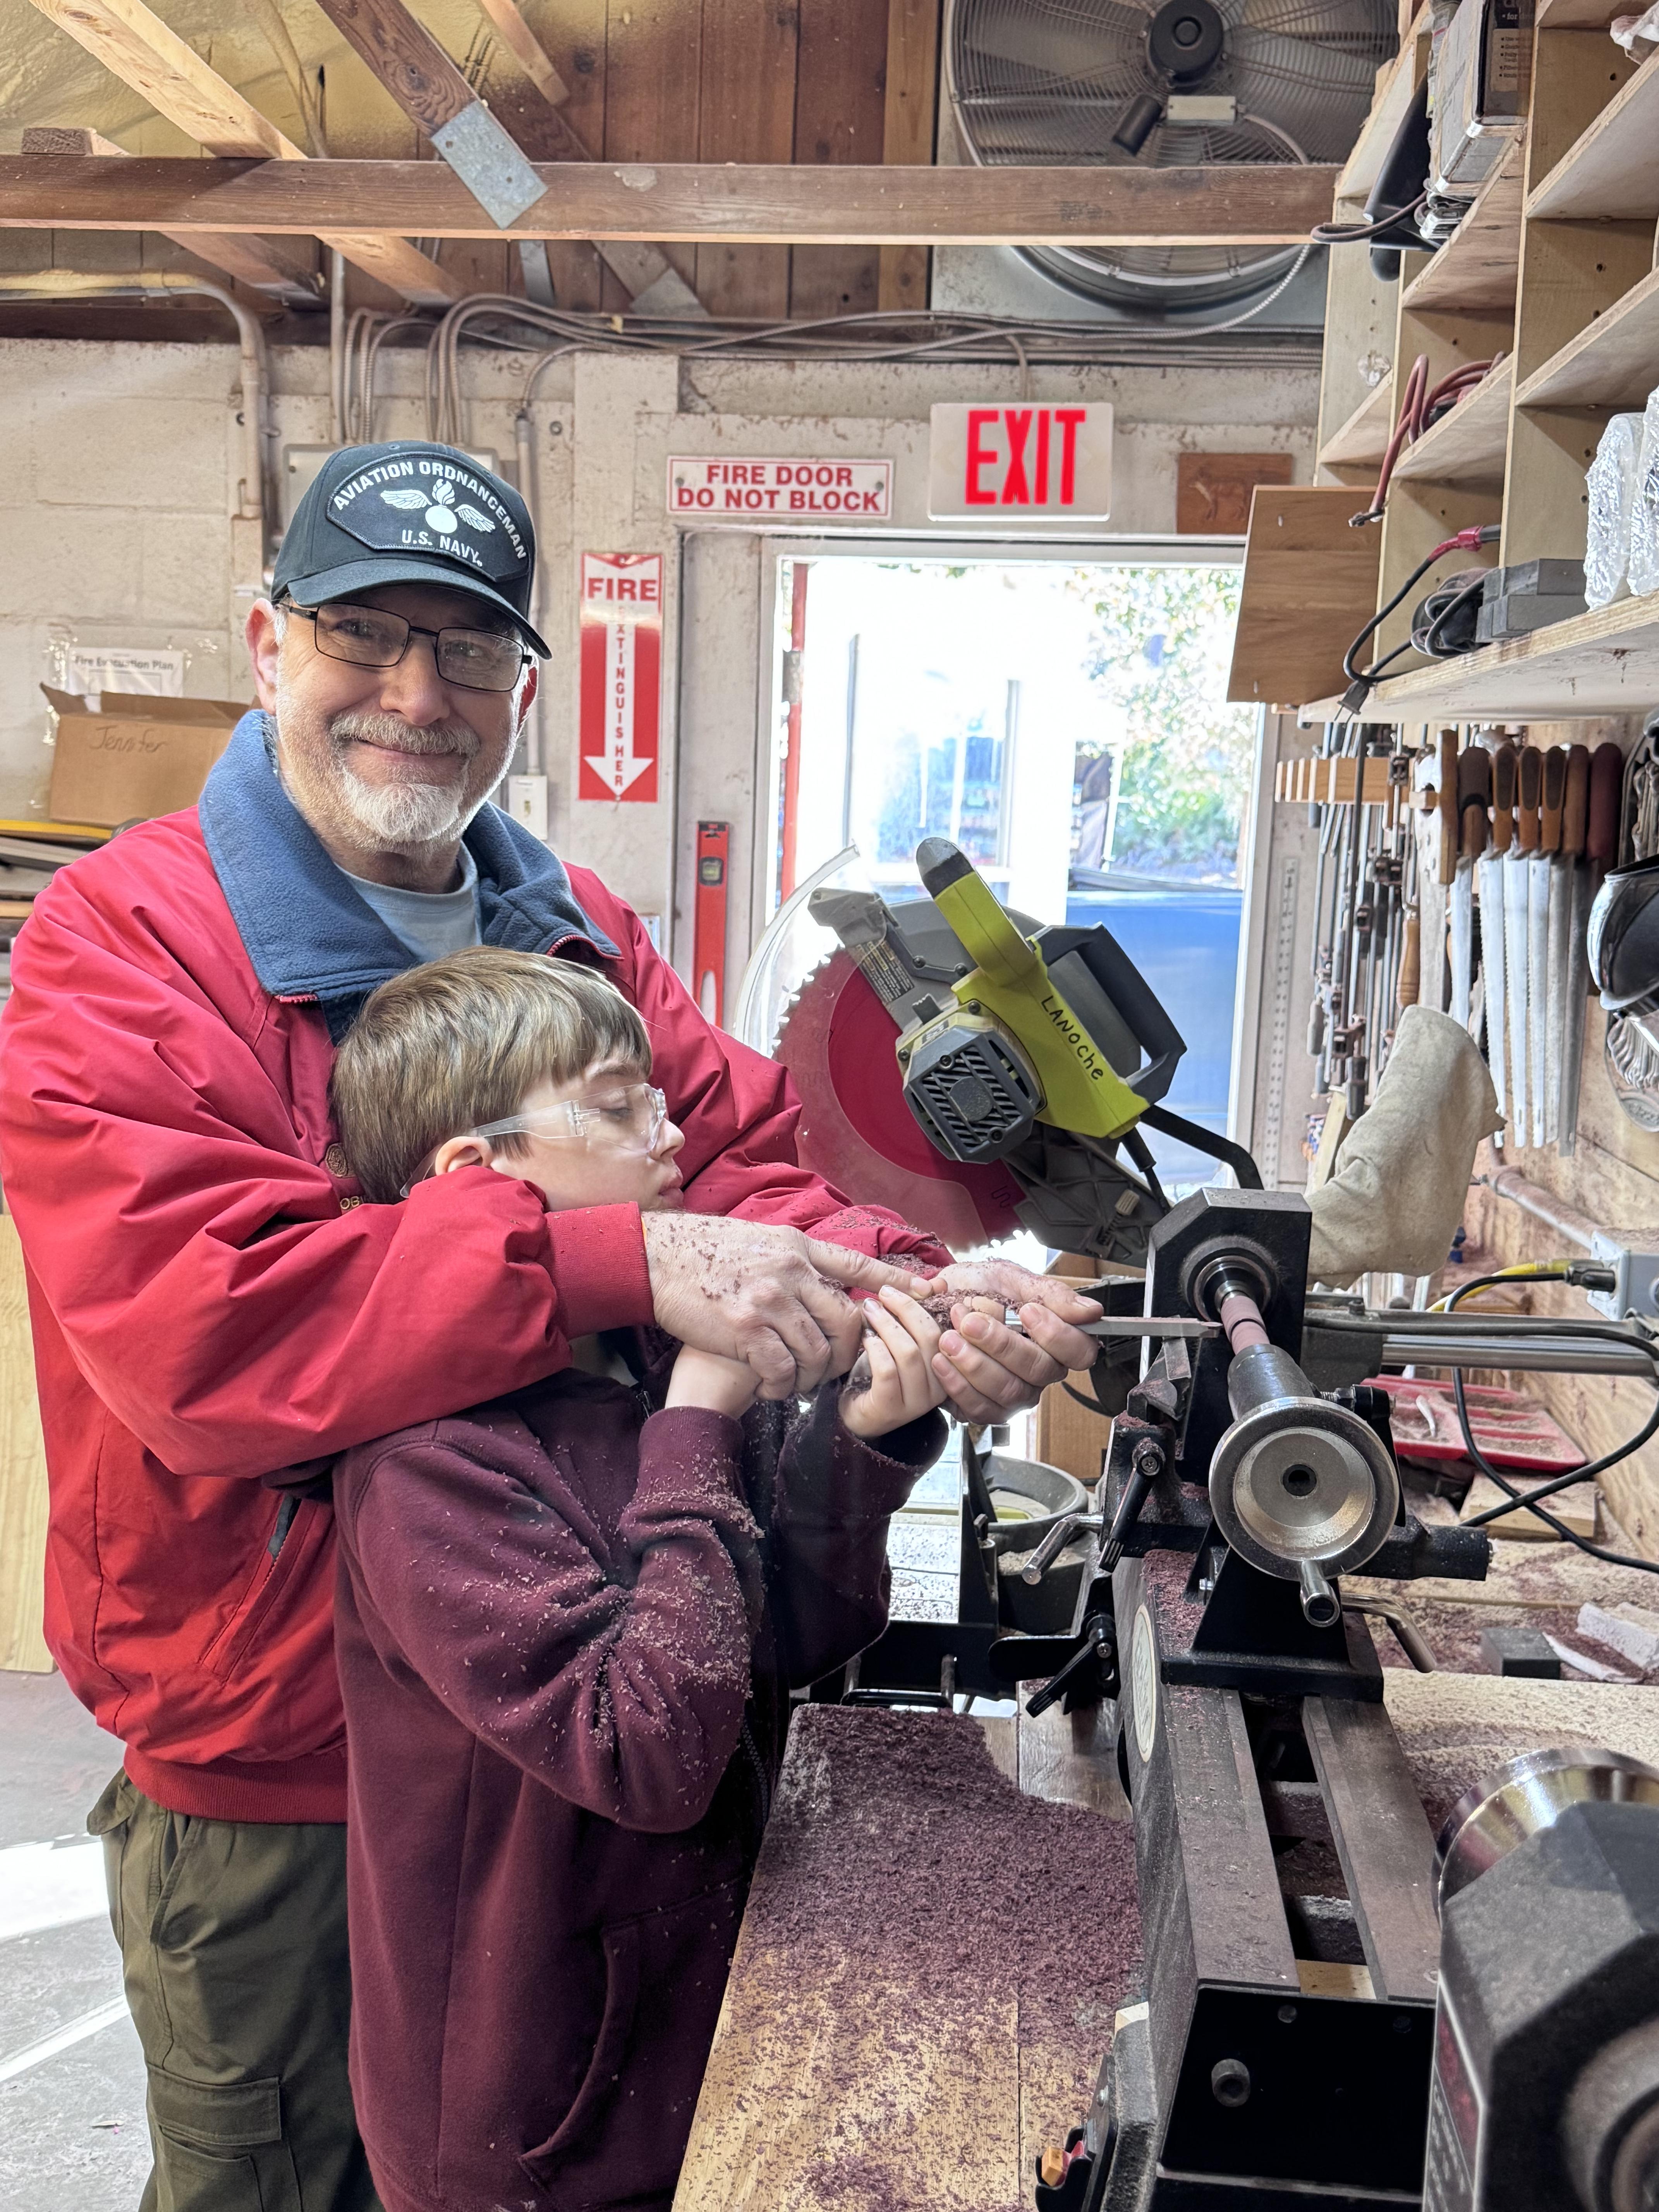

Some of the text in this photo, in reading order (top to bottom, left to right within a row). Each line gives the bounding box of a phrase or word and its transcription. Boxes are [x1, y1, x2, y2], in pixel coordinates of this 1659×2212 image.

[965, 410, 1086, 505] EXIT
[707, 464, 853, 487] FIRE DOOR
[333, 461, 526, 559] AVIATION ORDNANCEMAN
[677, 487, 880, 512] DO NOT BLOCK
[402, 529, 433, 546] U.S.
[588, 577, 657, 601] FIRE
[152, 659, 173, 670] Plan
